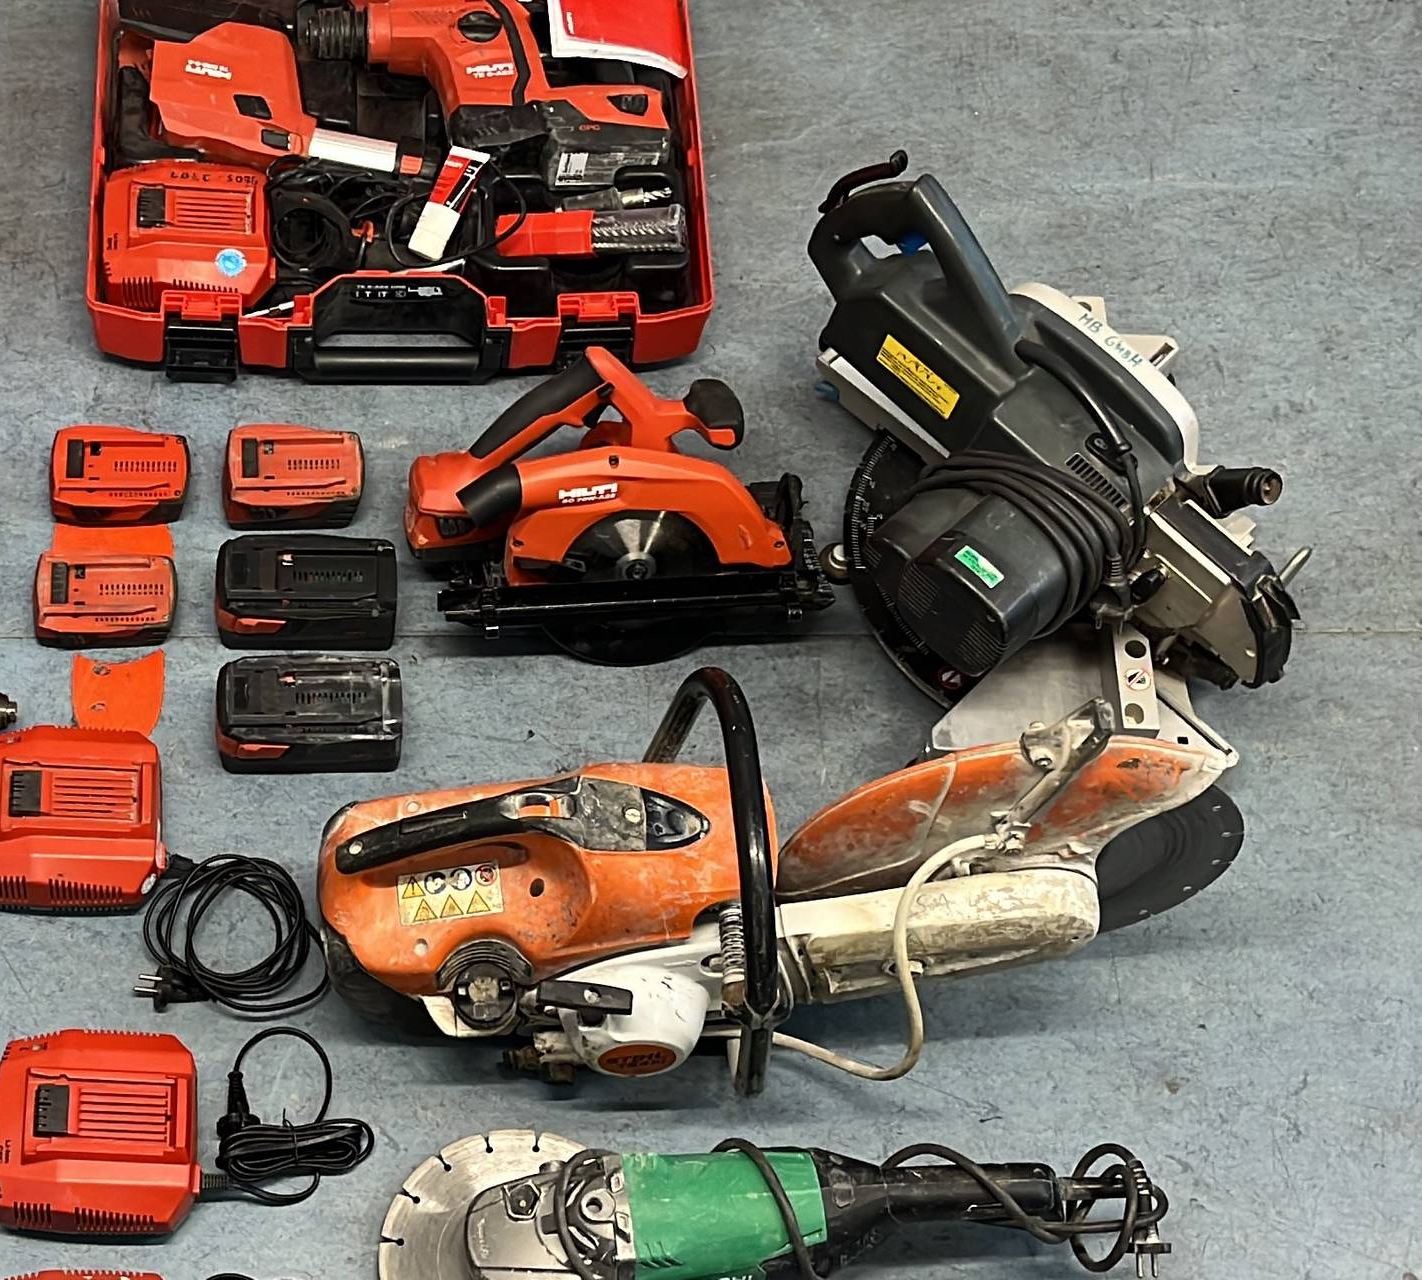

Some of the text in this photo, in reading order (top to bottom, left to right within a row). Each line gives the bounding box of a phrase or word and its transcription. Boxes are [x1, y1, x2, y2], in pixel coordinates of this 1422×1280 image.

[466, 63, 514, 74] HILTI
[1079, 313, 1103, 333] MB
[559, 482, 618, 499] HILTI
